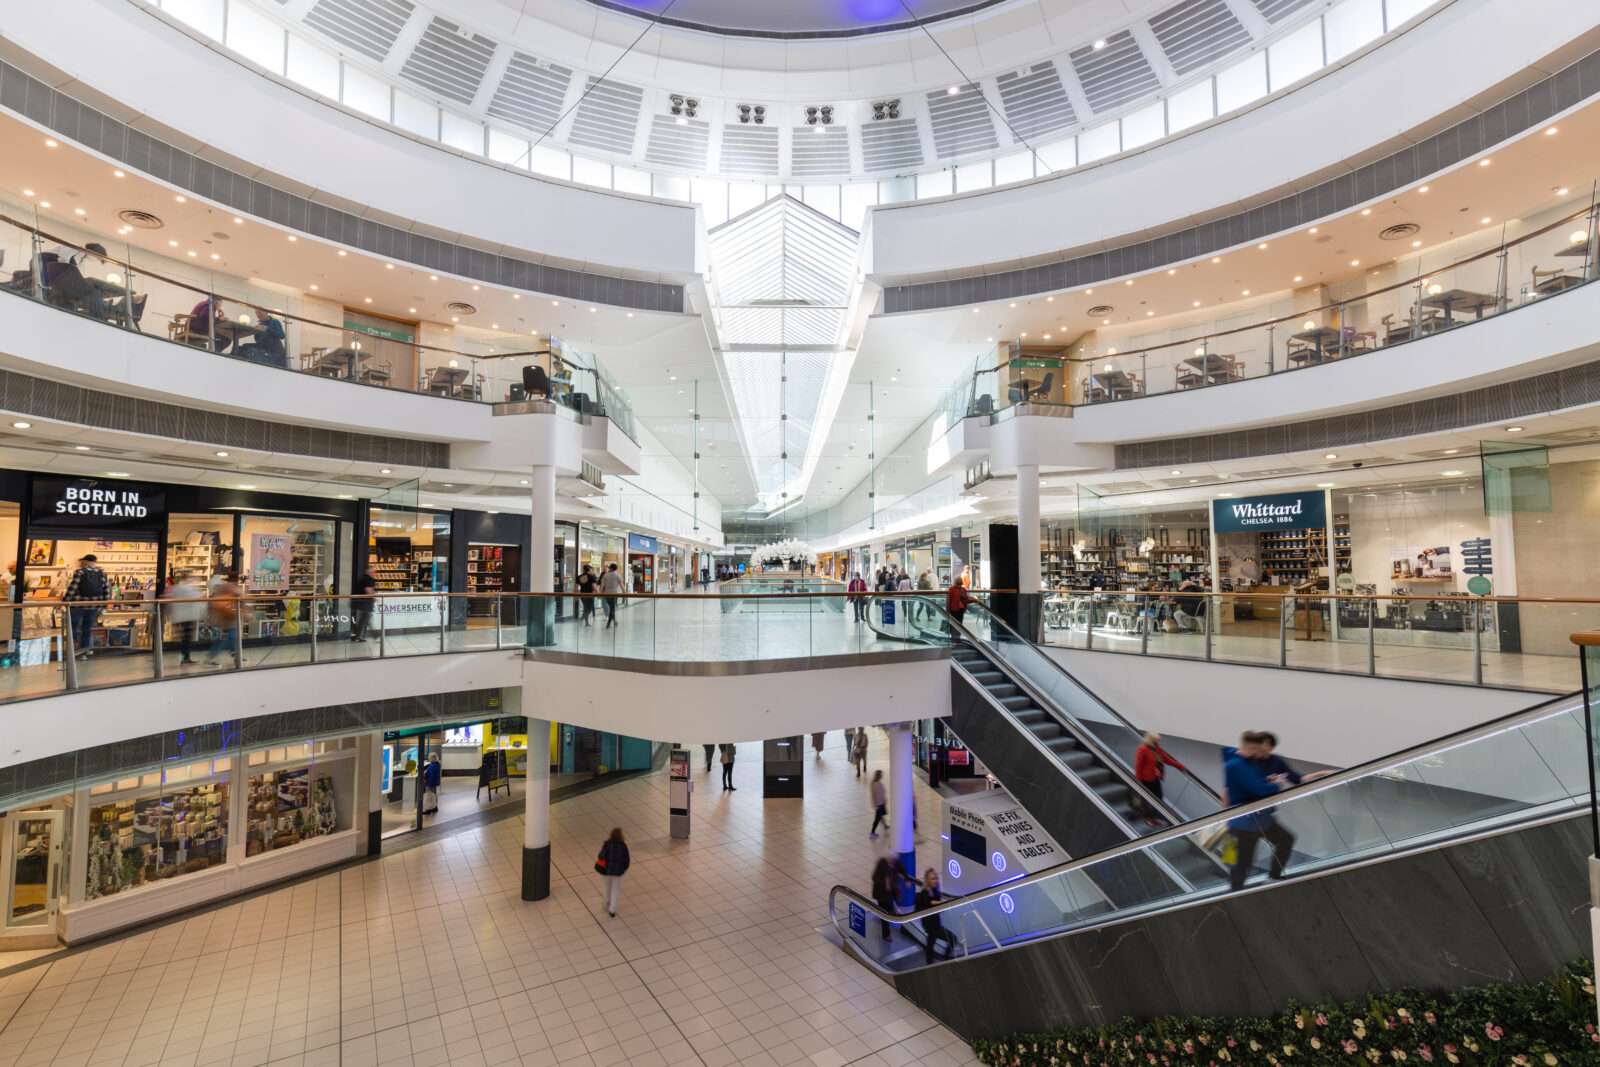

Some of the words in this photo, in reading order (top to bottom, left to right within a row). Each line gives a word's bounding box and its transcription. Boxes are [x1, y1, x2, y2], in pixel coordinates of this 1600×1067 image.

[66, 487, 116, 503] BORN
[122, 491, 139, 504] IN
[56, 501, 147, 518] SCOTLAND
[1232, 499, 1303, 518] Whittard
[1241, 517, 1274, 525] CHELSEA
[949, 806, 967, 819] Mobile
[967, 812, 985, 826] Phone
[991, 813, 1008, 824] WE
[1005, 811, 1021, 822] FIX
[998, 820, 1033, 836] PHONES
[1015, 833, 1036, 846] AND
[1017, 842, 1054, 859] TABLETS
